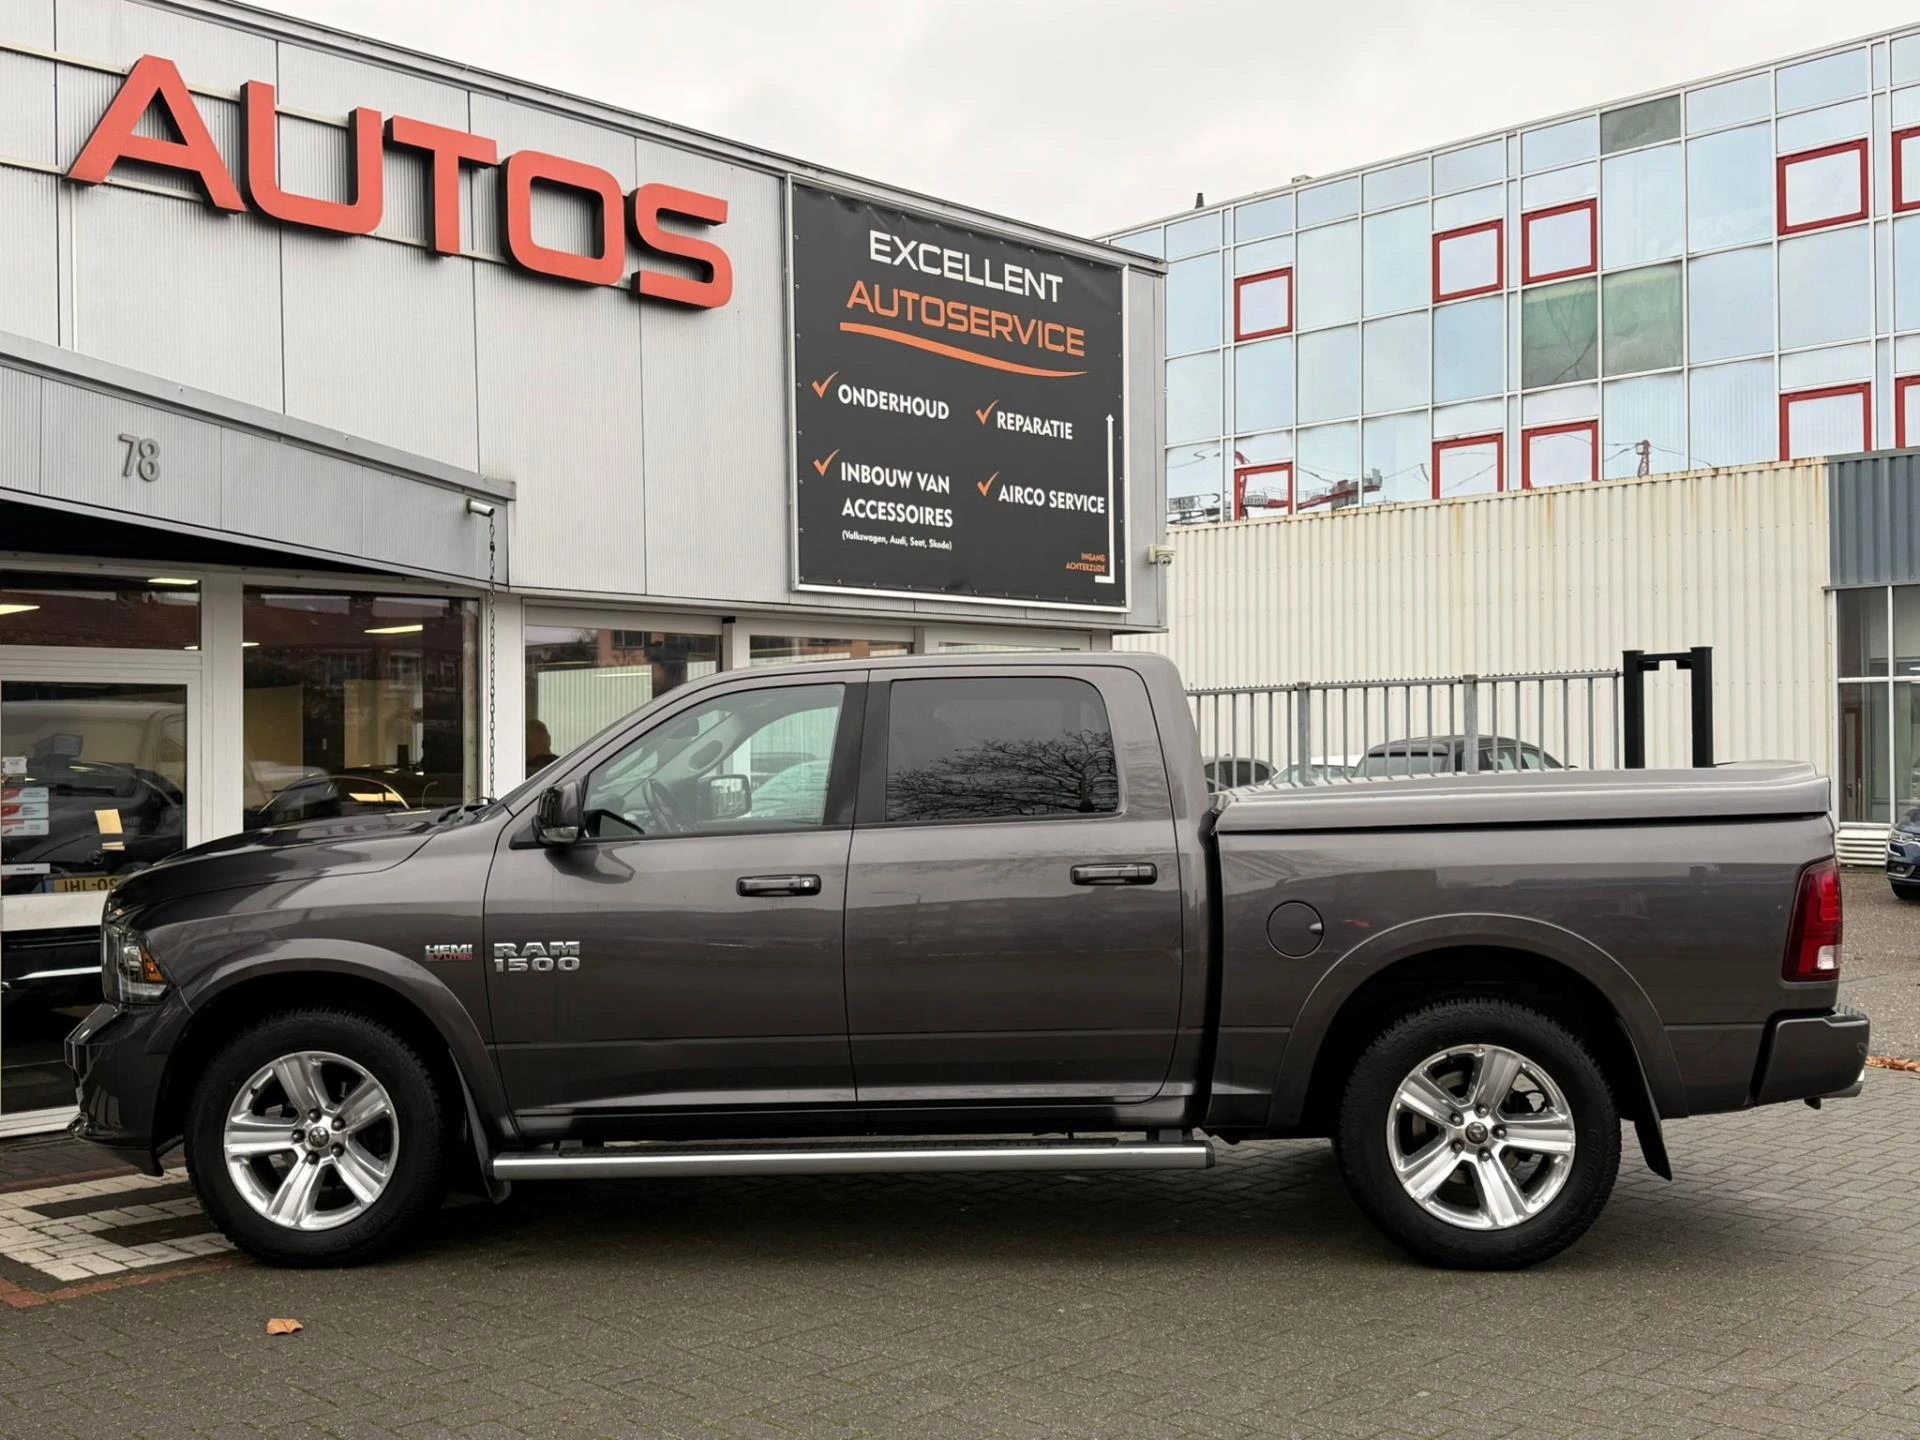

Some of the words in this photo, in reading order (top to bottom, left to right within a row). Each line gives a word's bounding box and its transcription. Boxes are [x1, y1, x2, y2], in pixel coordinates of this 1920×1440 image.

[64, 54, 733, 309] AUTOS
[870, 230, 1063, 302] EXCELLENT
[846, 280, 1085, 357] AUTOSERVICE
[838, 384, 949, 420] ONDERHOUD
[997, 411, 1073, 440] REPARATIE
[118, 433, 160, 482] 78
[841, 462, 913, 488] INBOUW
[916, 472, 949, 494] VAN
[842, 498, 953, 528] ACCESSOIRES
[998, 485, 1045, 506] AIRCO
[1049, 490, 1105, 514] SERVICE
[842, 529, 888, 545] (Volkswagen,
[889, 535, 908, 547] Audi,
[909, 536, 928, 549] Seat,
[425, 944, 472, 954] HEMI
[494, 941, 580, 957] RAM
[494, 957, 580, 972] 1500
